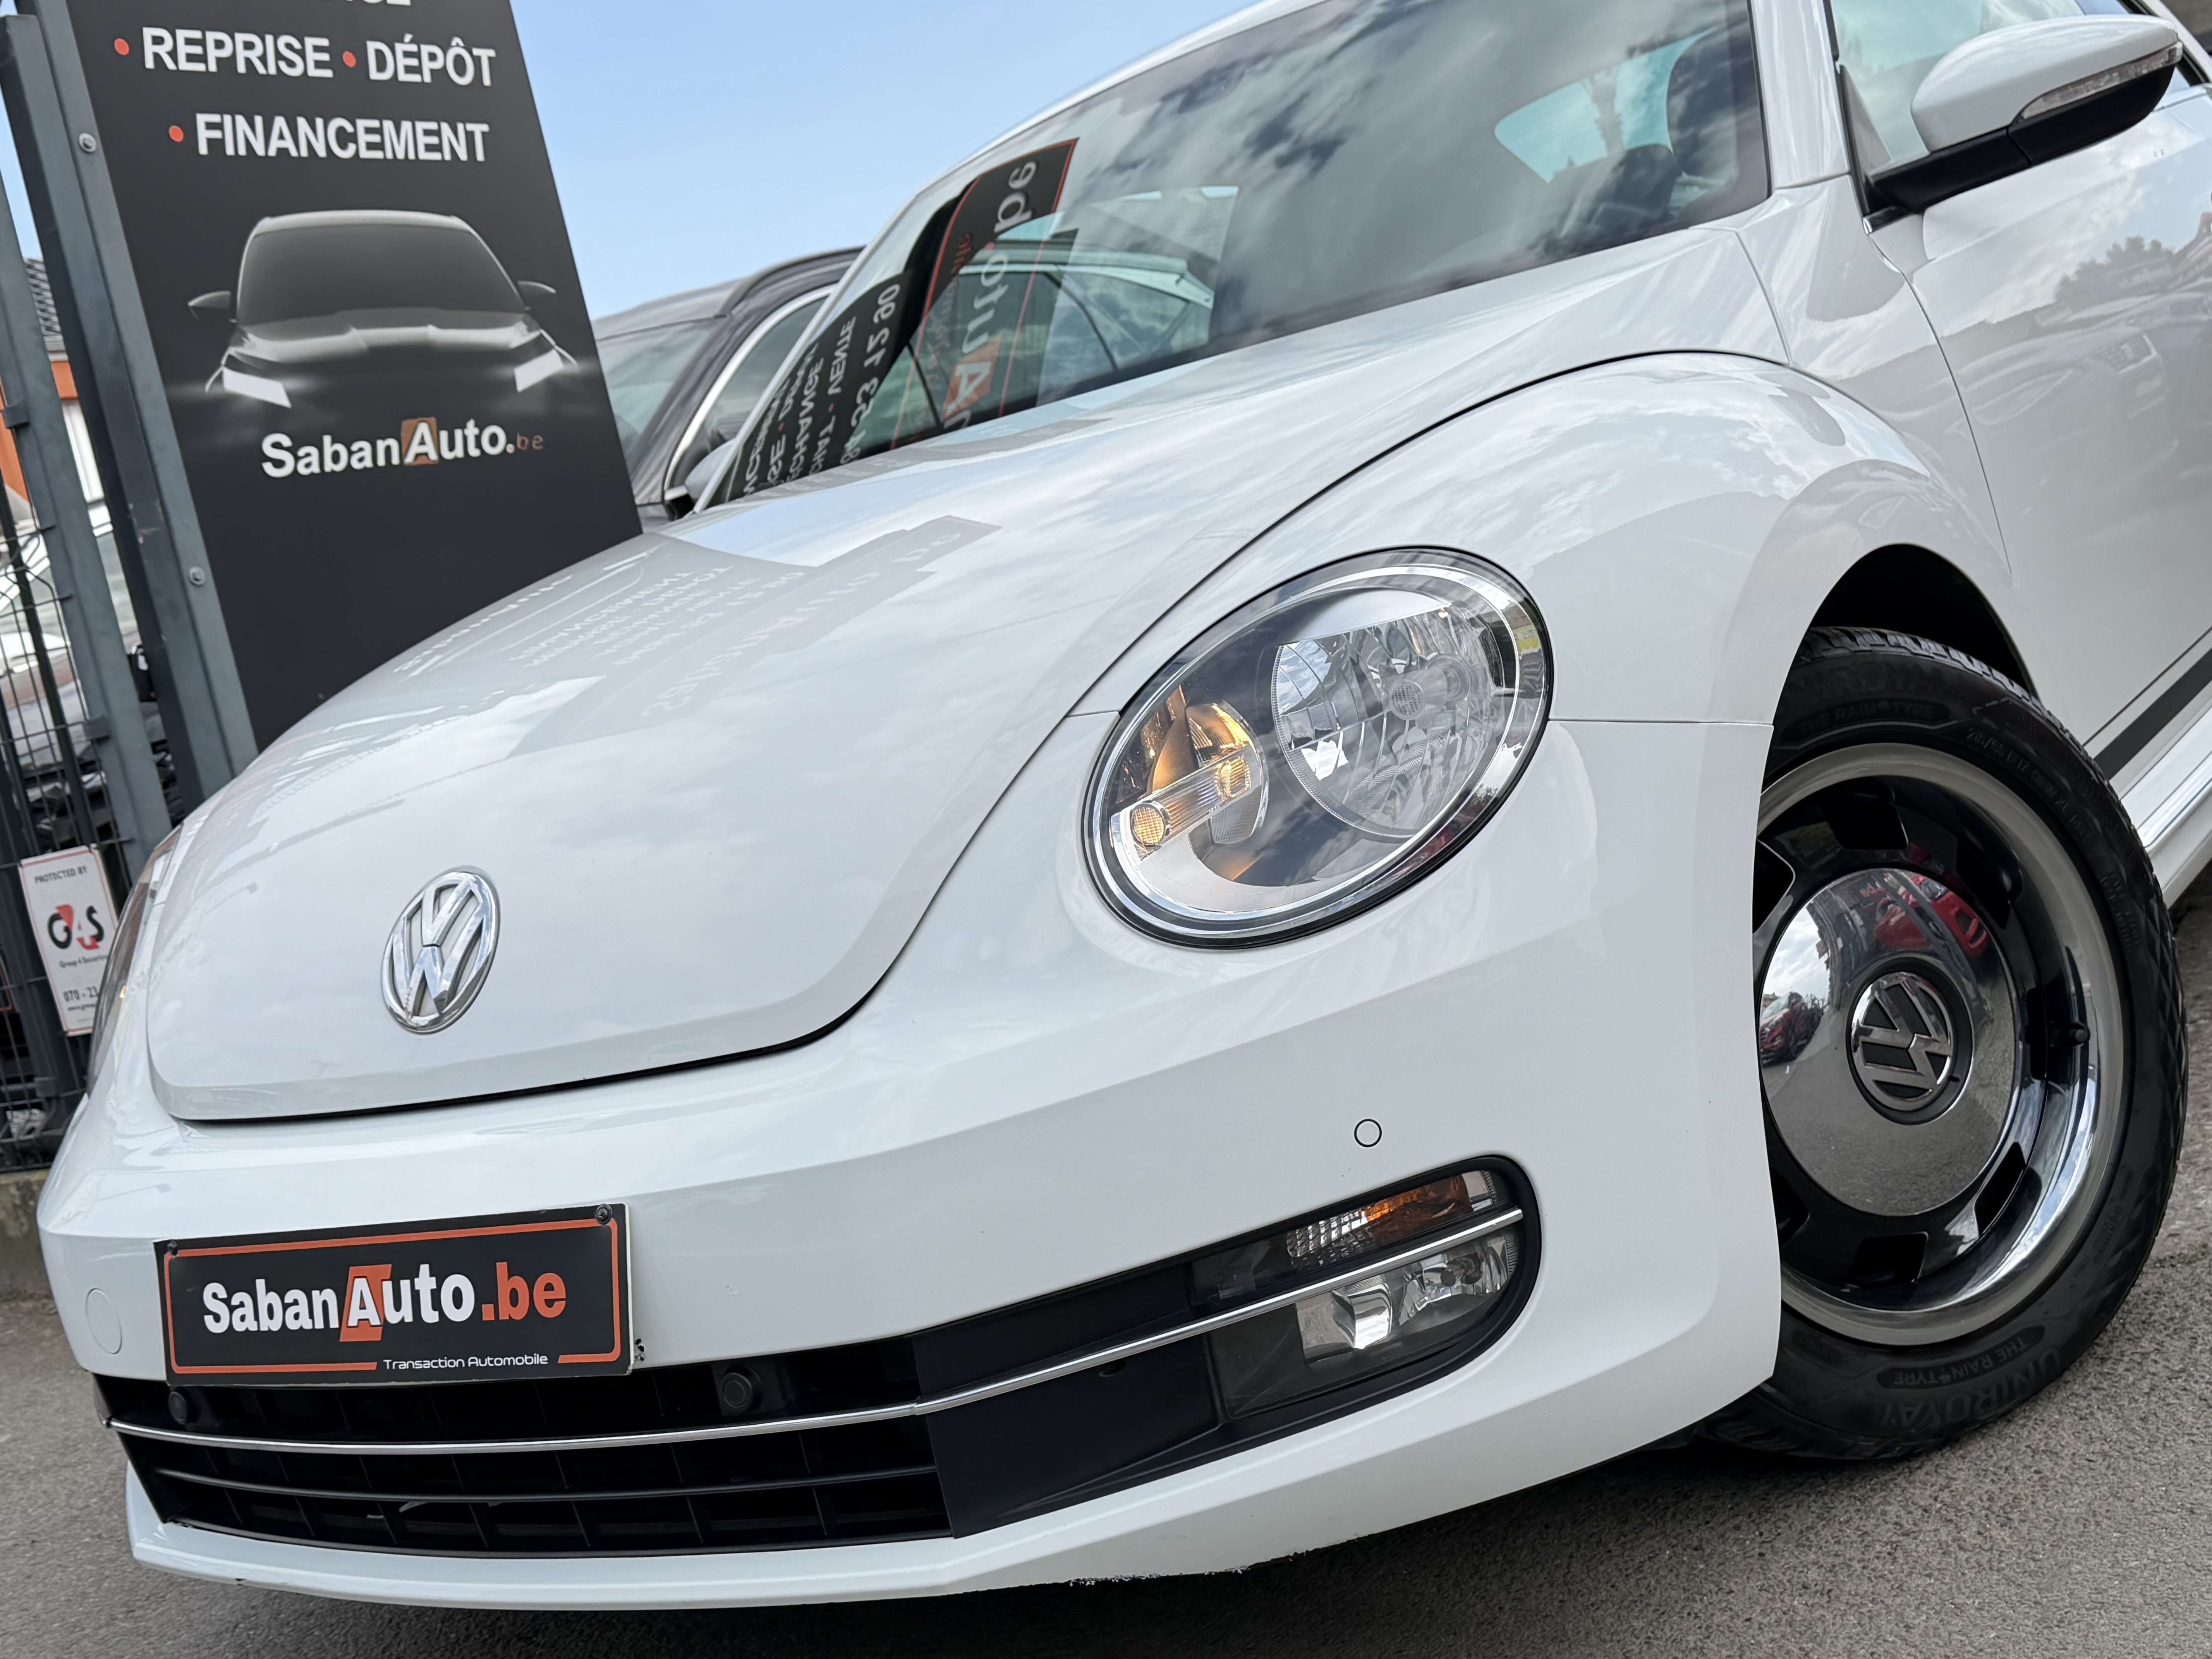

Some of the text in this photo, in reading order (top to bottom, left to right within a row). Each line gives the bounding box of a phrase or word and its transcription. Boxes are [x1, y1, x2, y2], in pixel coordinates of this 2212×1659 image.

[142, 27, 496, 86] REPRISE DÉPÔT
[195, 112, 490, 161] FINANCEMENT
[261, 418, 544, 477] SabanAuto.be
[47, 903, 104, 950] G4S
[202, 1261, 567, 1334] SabanAuto.be
[383, 1352, 549, 1371] Transaction Automobile
[1893, 1336, 2029, 1385] THE RAIN TYRE
